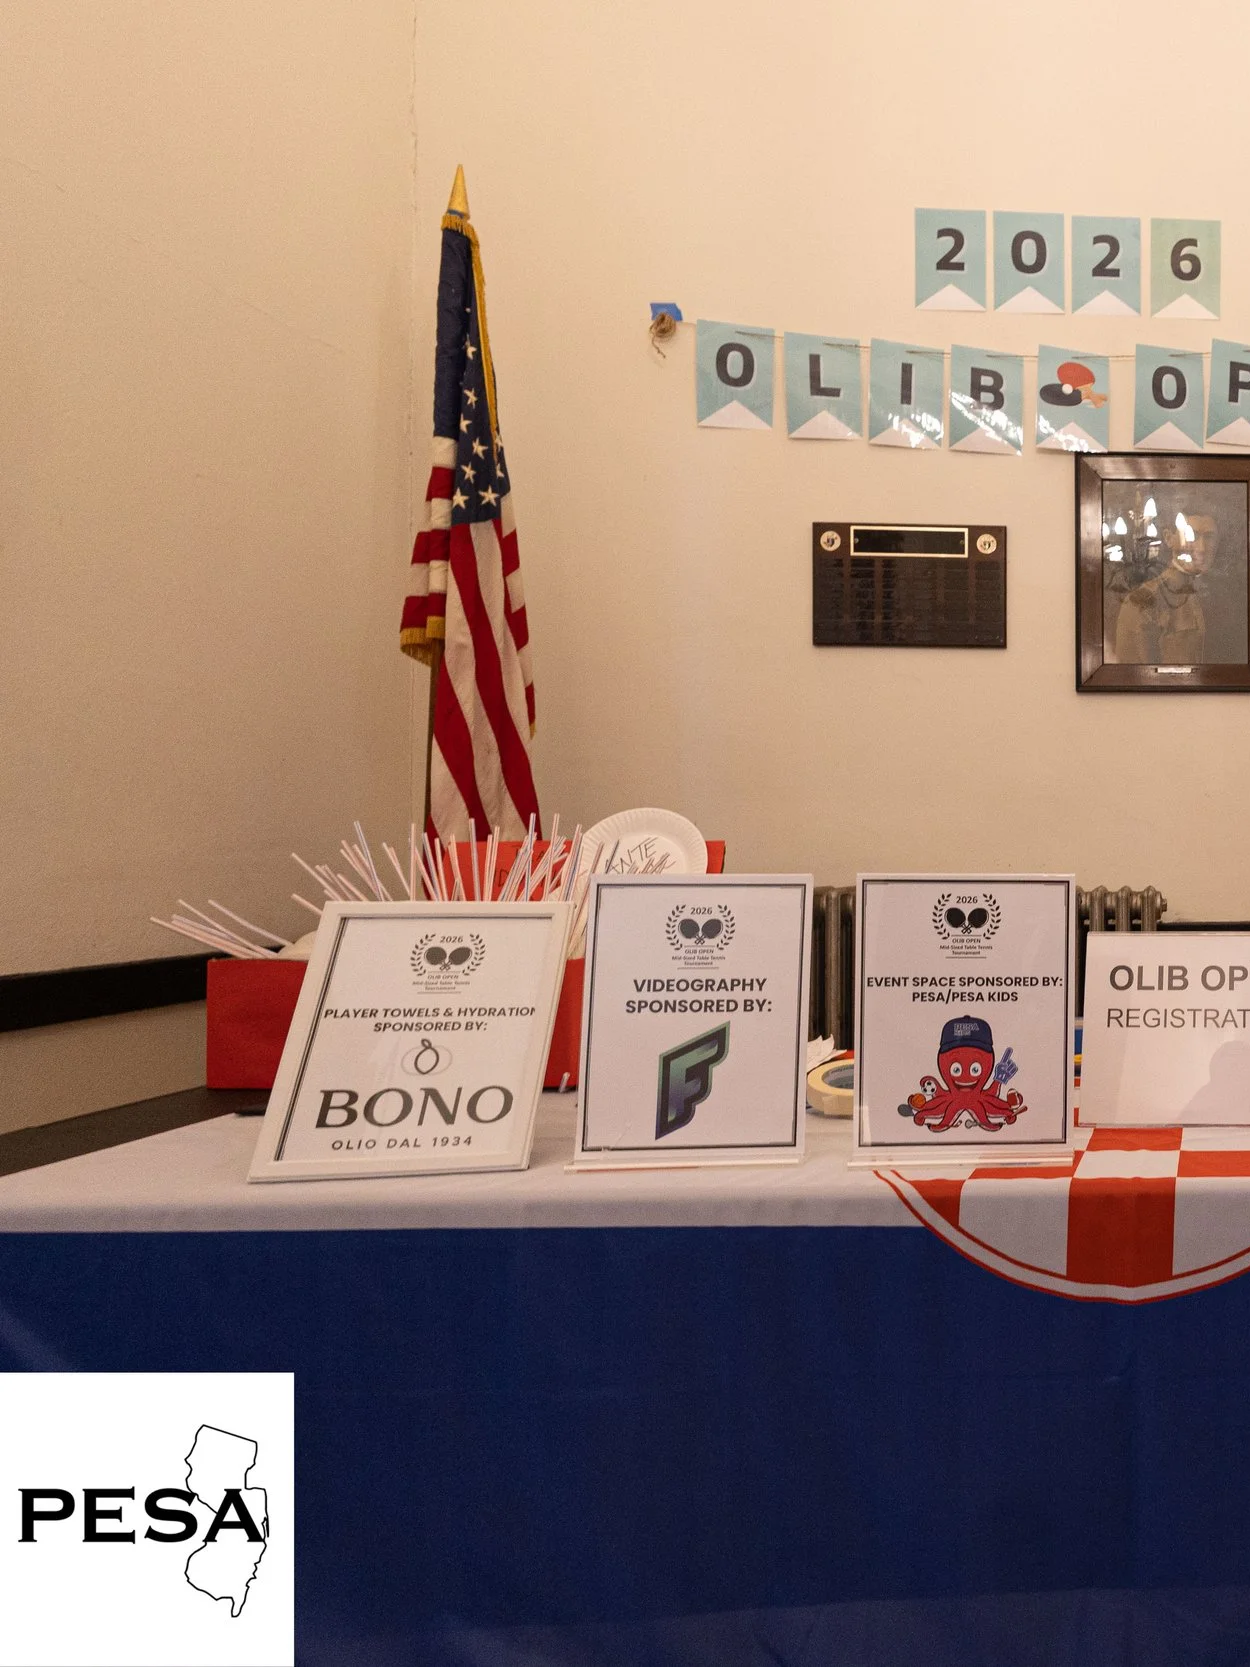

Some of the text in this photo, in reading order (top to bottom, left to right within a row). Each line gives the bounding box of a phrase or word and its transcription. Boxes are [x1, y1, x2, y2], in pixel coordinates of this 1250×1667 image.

[935, 227, 1202, 281] 2026
[715, 342, 1005, 411] OLIB
[956, 896, 978, 904] 2026
[690, 907, 713, 915] 2026
[440, 935, 464, 944] 2026
[633, 978, 767, 992] VIDEOGRAPHY
[867, 977, 1063, 987] EVENT SPACE SPONSORED BY:
[1109, 965, 1189, 991] OLIB
[912, 989, 1018, 1005] PESA/PESA KIDS
[324, 1008, 379, 1019] PLAYER
[383, 1008, 440, 1018] TOWELS
[443, 1007, 452, 1017] &
[625, 999, 772, 1013] SPONSORED BY:
[373, 1021, 488, 1032] SPONSORED BY:
[315, 1085, 513, 1128] BONO
[331, 1136, 472, 1150] OLIO DAL 1934
